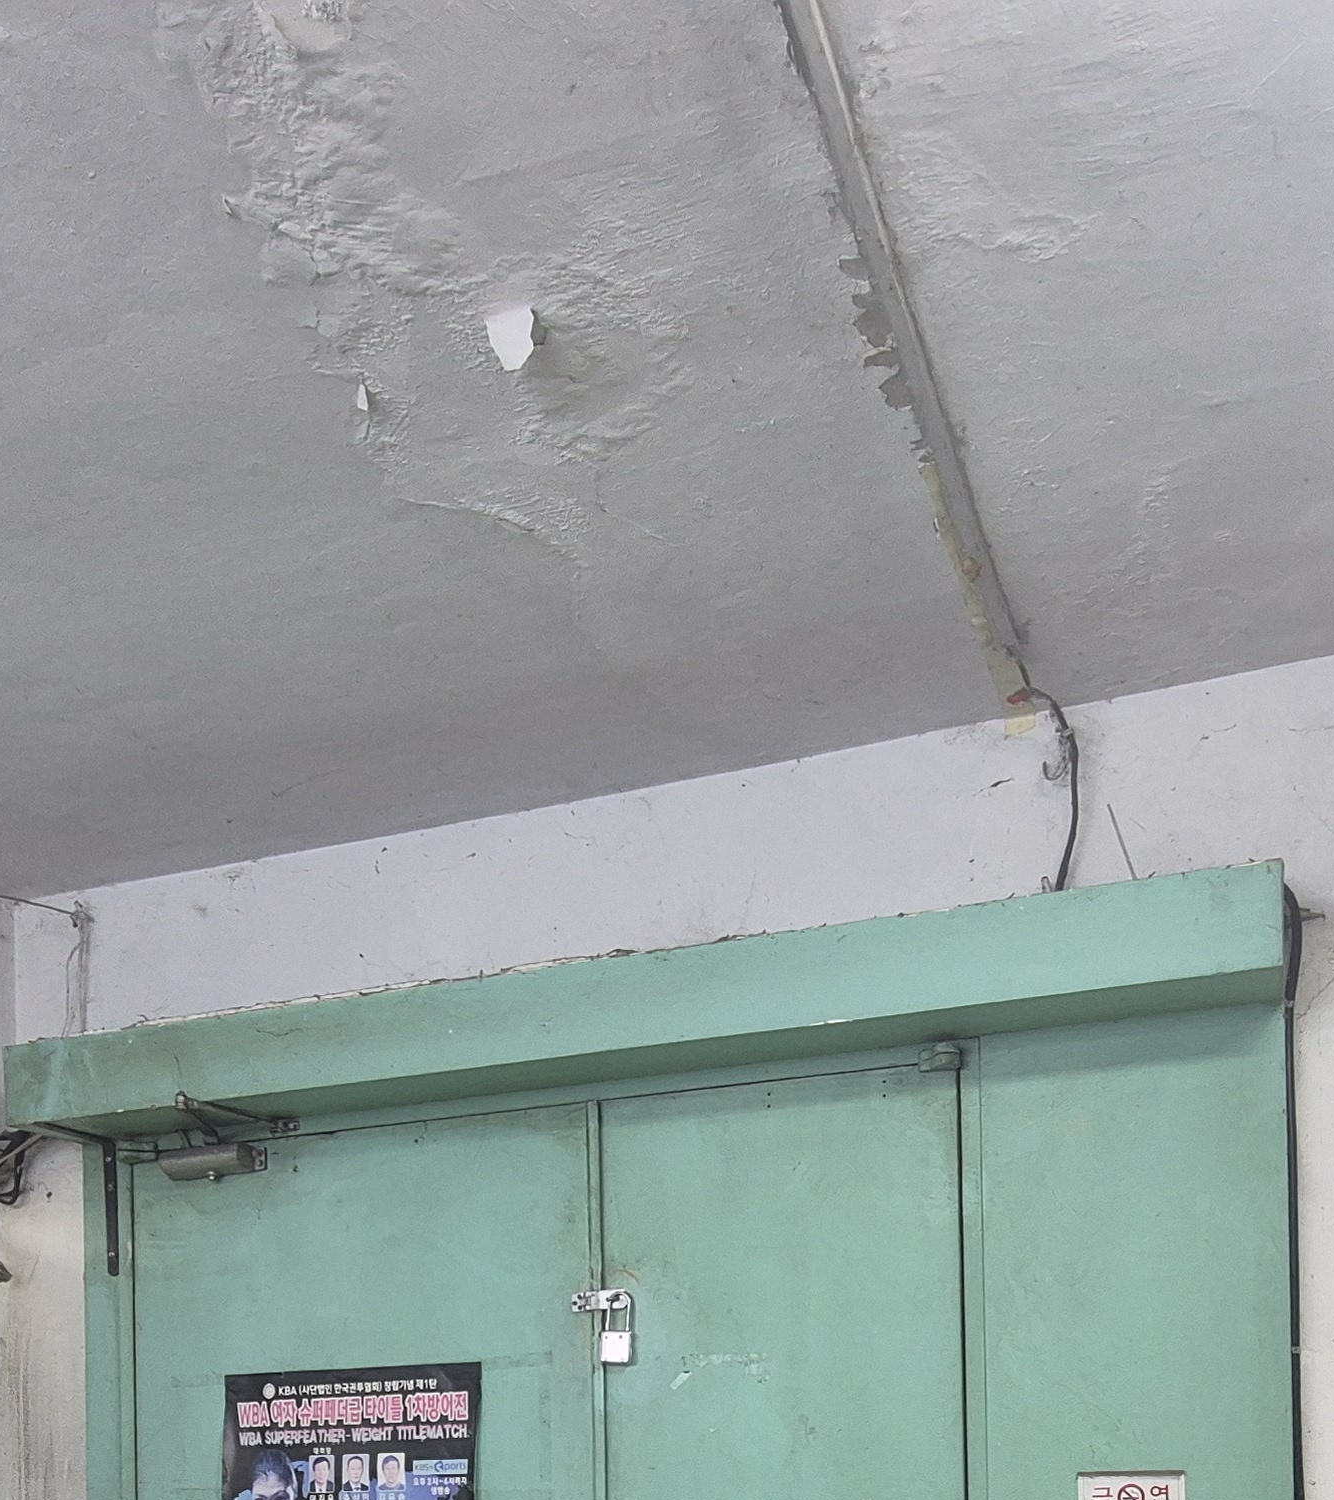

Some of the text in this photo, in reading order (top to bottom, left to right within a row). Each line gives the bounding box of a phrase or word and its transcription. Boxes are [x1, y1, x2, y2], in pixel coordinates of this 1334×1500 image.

[278, 1385, 297, 1397] KBA
[298, 1382, 333, 1397] (사단법인
[237, 1391, 470, 1428] WBA 여자 슈퍼페더급 타이틀 1차방어전
[238, 1431, 264, 1447] WBA
